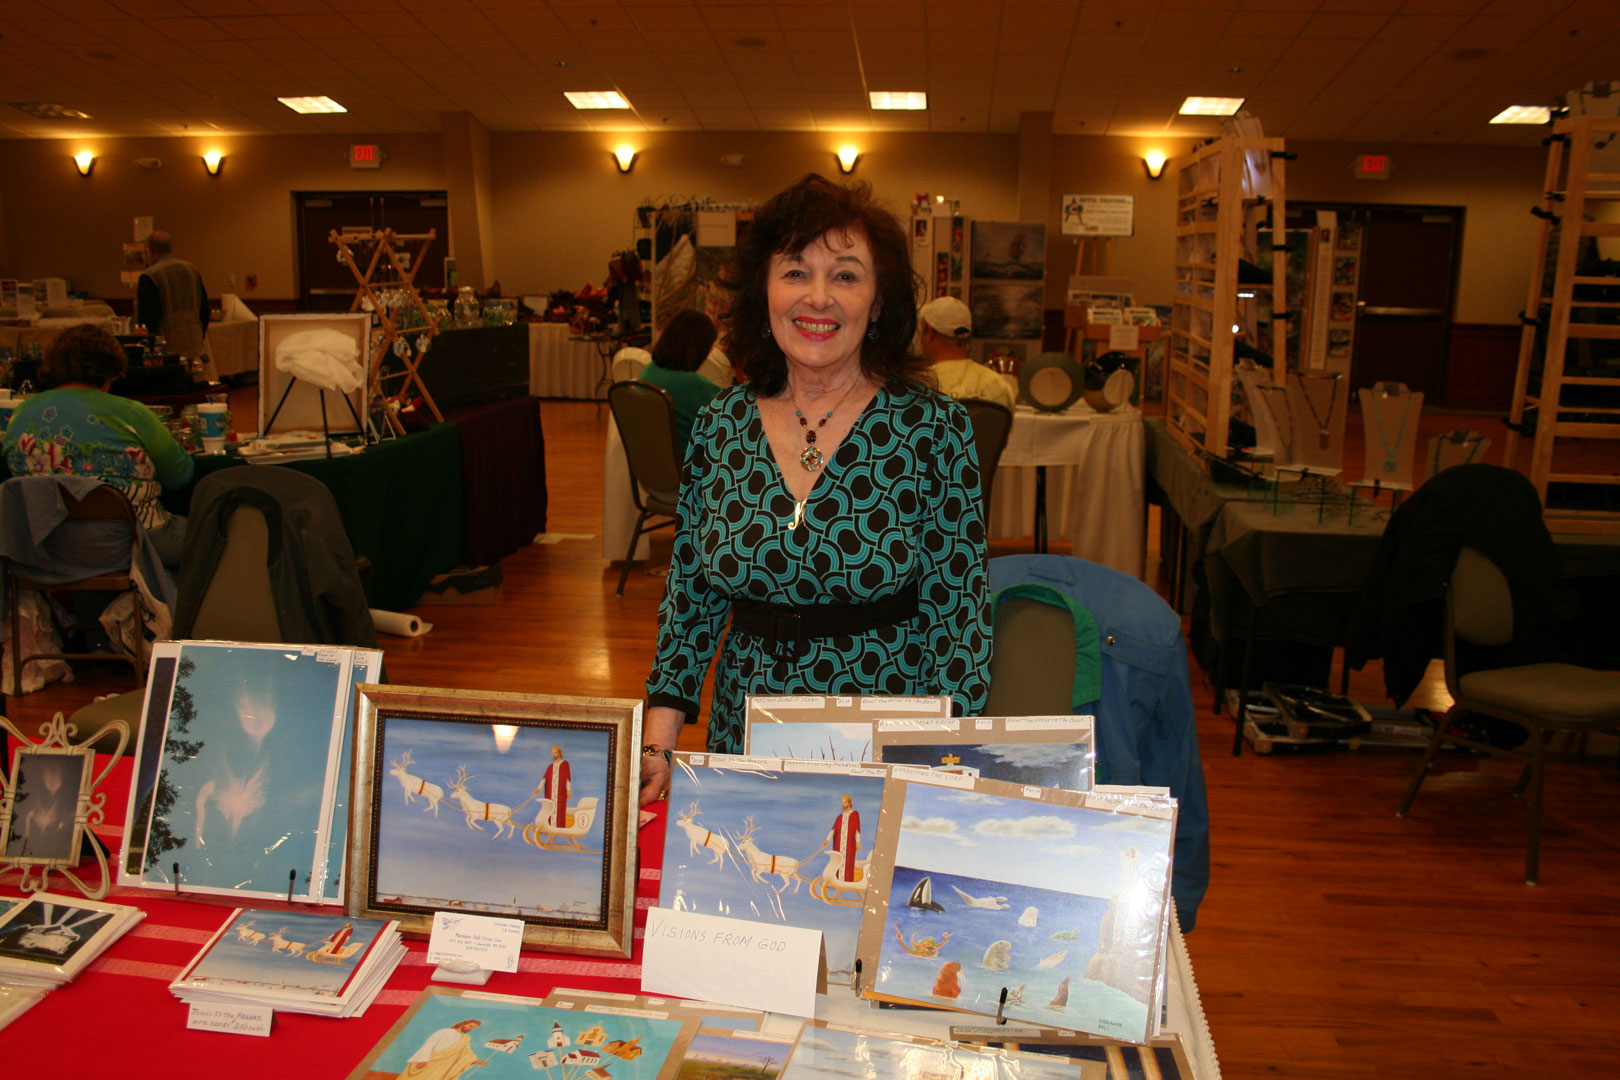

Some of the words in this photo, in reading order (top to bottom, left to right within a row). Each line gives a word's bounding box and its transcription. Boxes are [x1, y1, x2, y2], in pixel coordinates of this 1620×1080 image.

[355, 145, 375, 161] EXIT
[1362, 155, 1385, 173] EXIT
[651, 918, 706, 942] VISIONS
[713, 932, 753, 948] FROM
[757, 939, 787, 952] GOD
